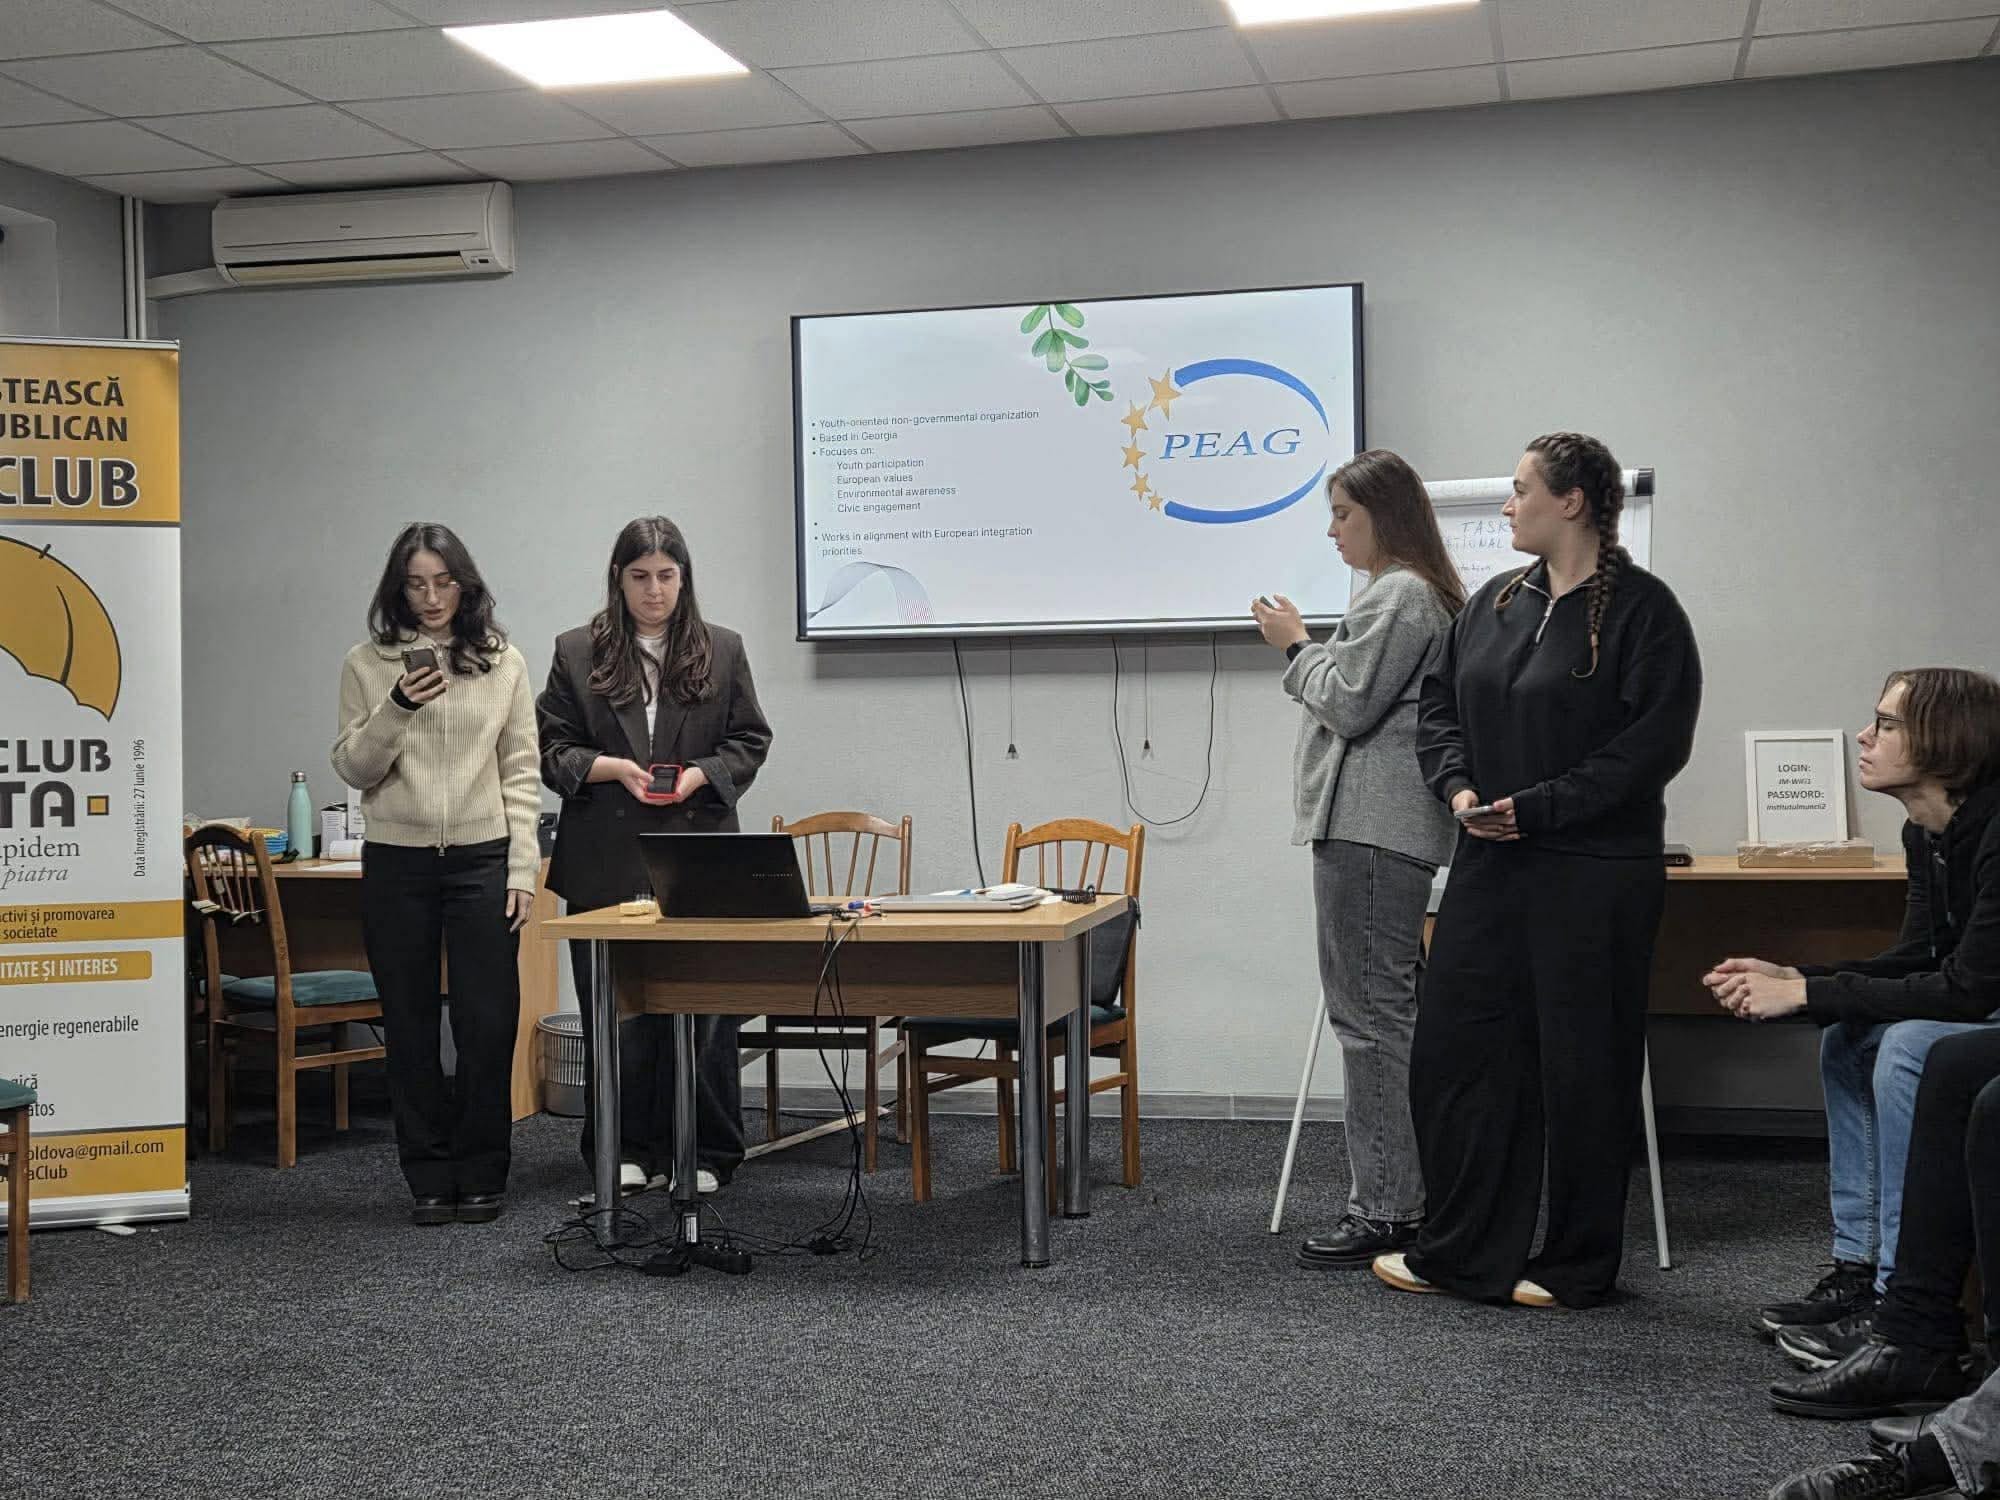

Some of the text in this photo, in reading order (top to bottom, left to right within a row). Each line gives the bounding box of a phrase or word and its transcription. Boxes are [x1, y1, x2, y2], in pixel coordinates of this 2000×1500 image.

[0, 376, 124, 407] TEASCĂ
[891, 414, 978, 425] non-governmental
[980, 410, 1039, 422] organization
[819, 431, 898, 442] Based in Georgia
[1159, 428, 1300, 459] PEAG
[819, 447, 858, 456] Focuses
[836, 459, 924, 470] Youth participation
[837, 474, 913, 485] European values
[837, 487, 956, 499] Environmental awareness
[837, 502, 921, 514] Civic engagement
[1460, 520, 1509, 535] TASK
[821, 532, 850, 542] Works
[852, 532, 861, 540] in
[863, 531, 909, 542] alignment
[911, 530, 932, 539] with
[934, 529, 979, 540] European
[822, 547, 863, 557] priorities
[133, 739, 145, 761] 1996
[1778, 764, 1811, 772] LOGIN:
[133, 788, 145, 800] 27
[1767, 790, 1825, 799] PASSWORD:
[0, 835, 81, 866] pidem
[133, 856, 146, 877] Data
[0, 909, 28, 922] ctivi
[43, 908, 115, 924] promovarea
[3, 926, 58, 939] societate
[60, 957, 118, 976] INTERES
[0, 1015, 139, 1041] energie regenerabile
